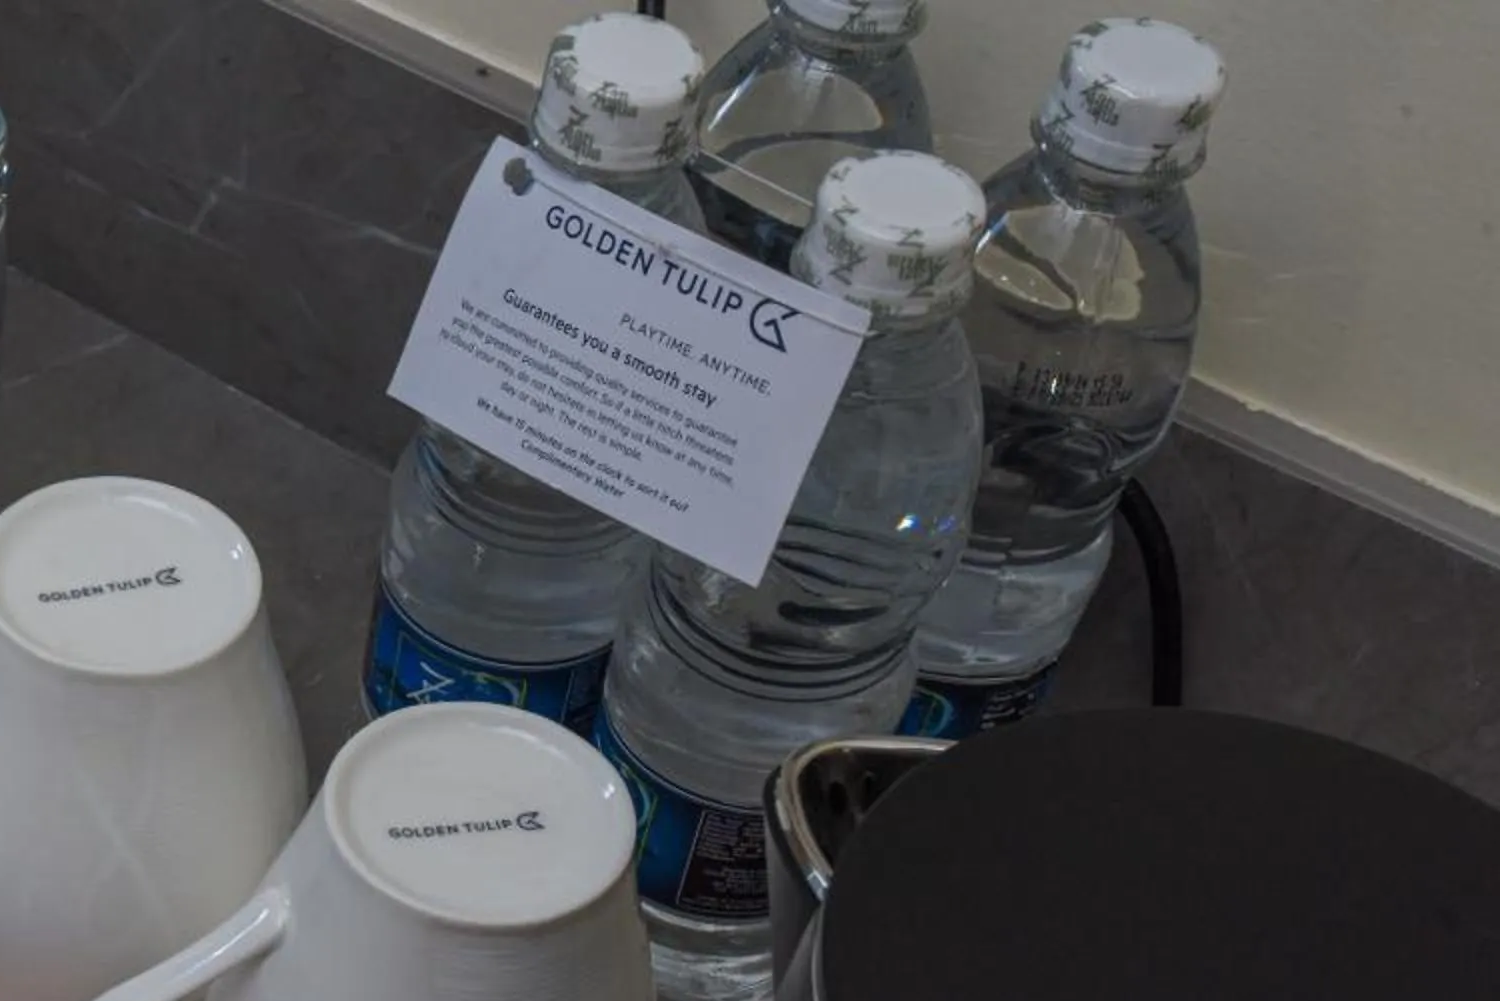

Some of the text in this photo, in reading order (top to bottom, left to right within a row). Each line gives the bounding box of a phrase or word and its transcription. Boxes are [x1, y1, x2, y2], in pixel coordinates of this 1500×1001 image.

[546, 205, 743, 313] GOLDEN TULIP
[440, 328, 450, 339] to
[450, 334, 475, 353] cloud
[475, 348, 495, 363] your
[517, 371, 529, 383] do
[530, 379, 547, 392] not
[547, 386, 585, 412] hesitate
[597, 412, 630, 437] letting
[631, 432, 644, 442] us
[645, 435, 672, 455] know
[674, 452, 686, 461] at
[687, 457, 707, 473] any
[452, 317, 468, 330] you
[470, 324, 485, 338] the
[484, 334, 521, 358] greatest
[521, 355, 559, 378] possible
[632, 409, 655, 427] little
[685, 435, 733, 465] threatens
[476, 310, 490, 321] are
[491, 318, 538, 348] committed
[539, 342, 548, 354] to
[548, 349, 594, 379] providing
[595, 373, 629, 396] quality
[630, 390, 670, 416] services
[672, 410, 683, 421] to
[503, 288, 717, 408] Guarantees you a smooth stay
[620, 313, 770, 395] PLAYTIME. ANYTIME.
[492, 406, 513, 423] have
[524, 426, 563, 450] minutes
[563, 447, 577, 458] on
[579, 453, 595, 466] the
[596, 463, 622, 480] clock
[624, 476, 635, 486] to
[636, 483, 659, 497] sort
[669, 499, 689, 512] out
[500, 382, 516, 396] day
[518, 391, 528, 402] or
[559, 410, 577, 428] The
[577, 423, 597, 437] rest
[598, 434, 607, 444] is
[594, 478, 624, 496] Water
[38, 576, 153, 603] GOLDEN TULIP
[387, 818, 513, 840] GOLDEN TULIP
